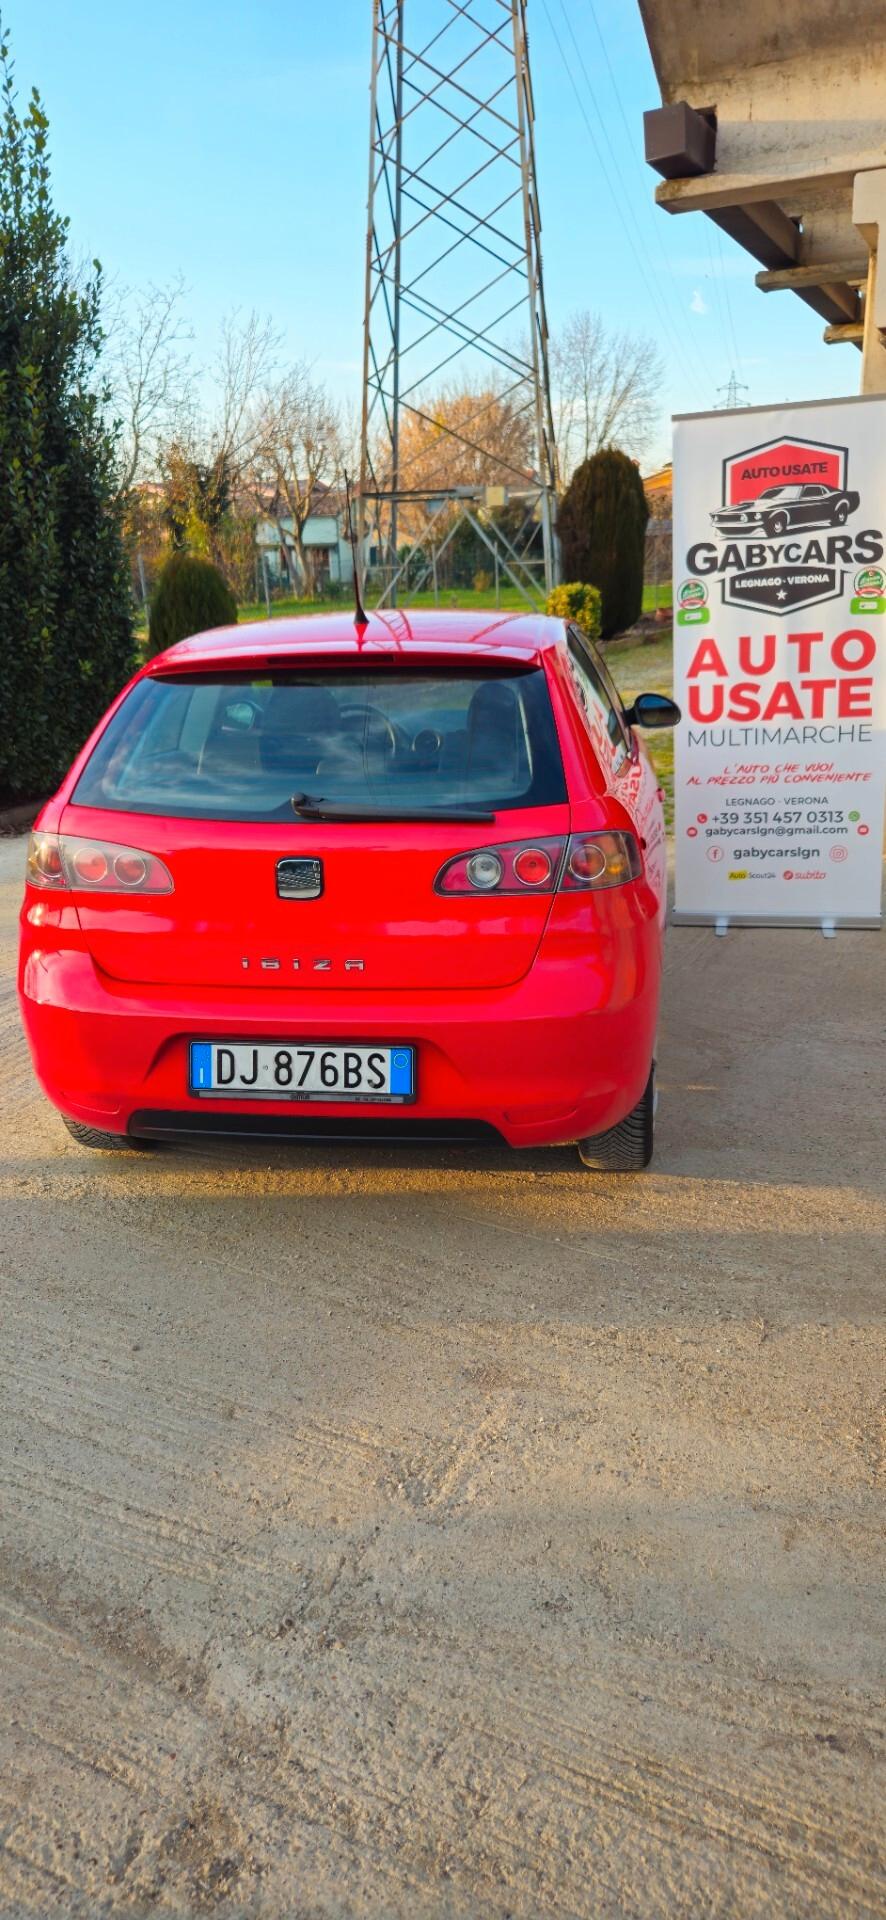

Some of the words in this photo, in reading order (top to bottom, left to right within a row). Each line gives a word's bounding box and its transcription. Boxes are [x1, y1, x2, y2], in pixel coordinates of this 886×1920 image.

[741, 465, 780, 480] AUTO
[782, 461, 829, 476] USATE
[686, 530, 884, 576] GABYCARS
[735, 576, 782, 589] LEGNAGO
[787, 574, 830, 585] VERONA
[686, 629, 877, 678] AUTO
[688, 677, 873, 723] USATE
[688, 724, 873, 748] MULTIMARCHE
[723, 763, 769, 774] L'AUTO
[775, 763, 799, 773] CHE
[805, 762, 834, 773] VUOI
[686, 776, 702, 786] AL
[707, 775, 755, 786] PREZZO
[784, 772, 873, 783] CONVENIENTE
[725, 798, 776, 807] LEGNAGO
[784, 797, 829, 806] VERONA
[712, 812, 739, 825] +39
[743, 811, 768, 824] 351
[772, 811, 802, 824] 457
[806, 810, 844, 824] 0313
[216, 1049, 259, 1085] DJ
[274, 1050, 386, 1089] 876BS
